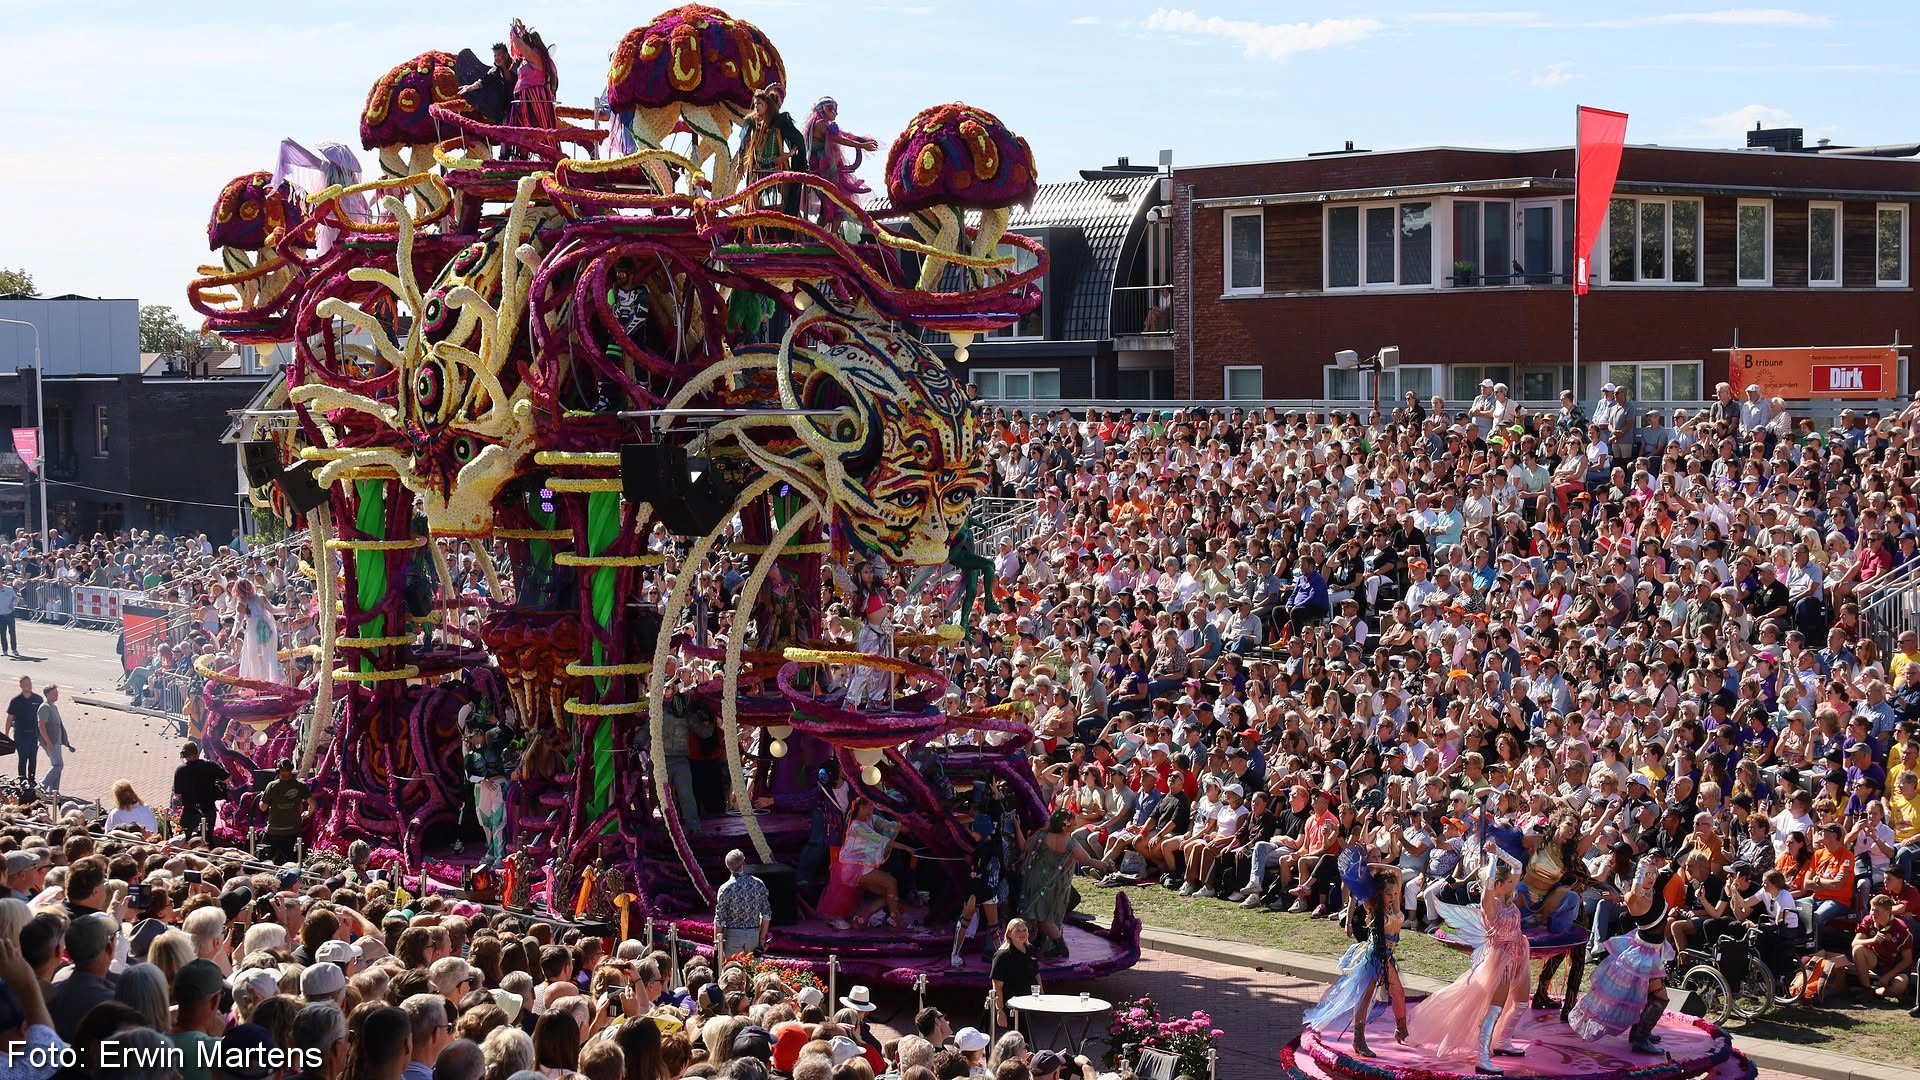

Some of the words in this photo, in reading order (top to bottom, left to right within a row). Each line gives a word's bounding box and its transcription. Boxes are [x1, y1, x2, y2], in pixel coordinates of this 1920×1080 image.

[1744, 354, 1753, 369] B
[1755, 358, 1784, 367] tribune
[1829, 367, 1863, 389] Dirk
